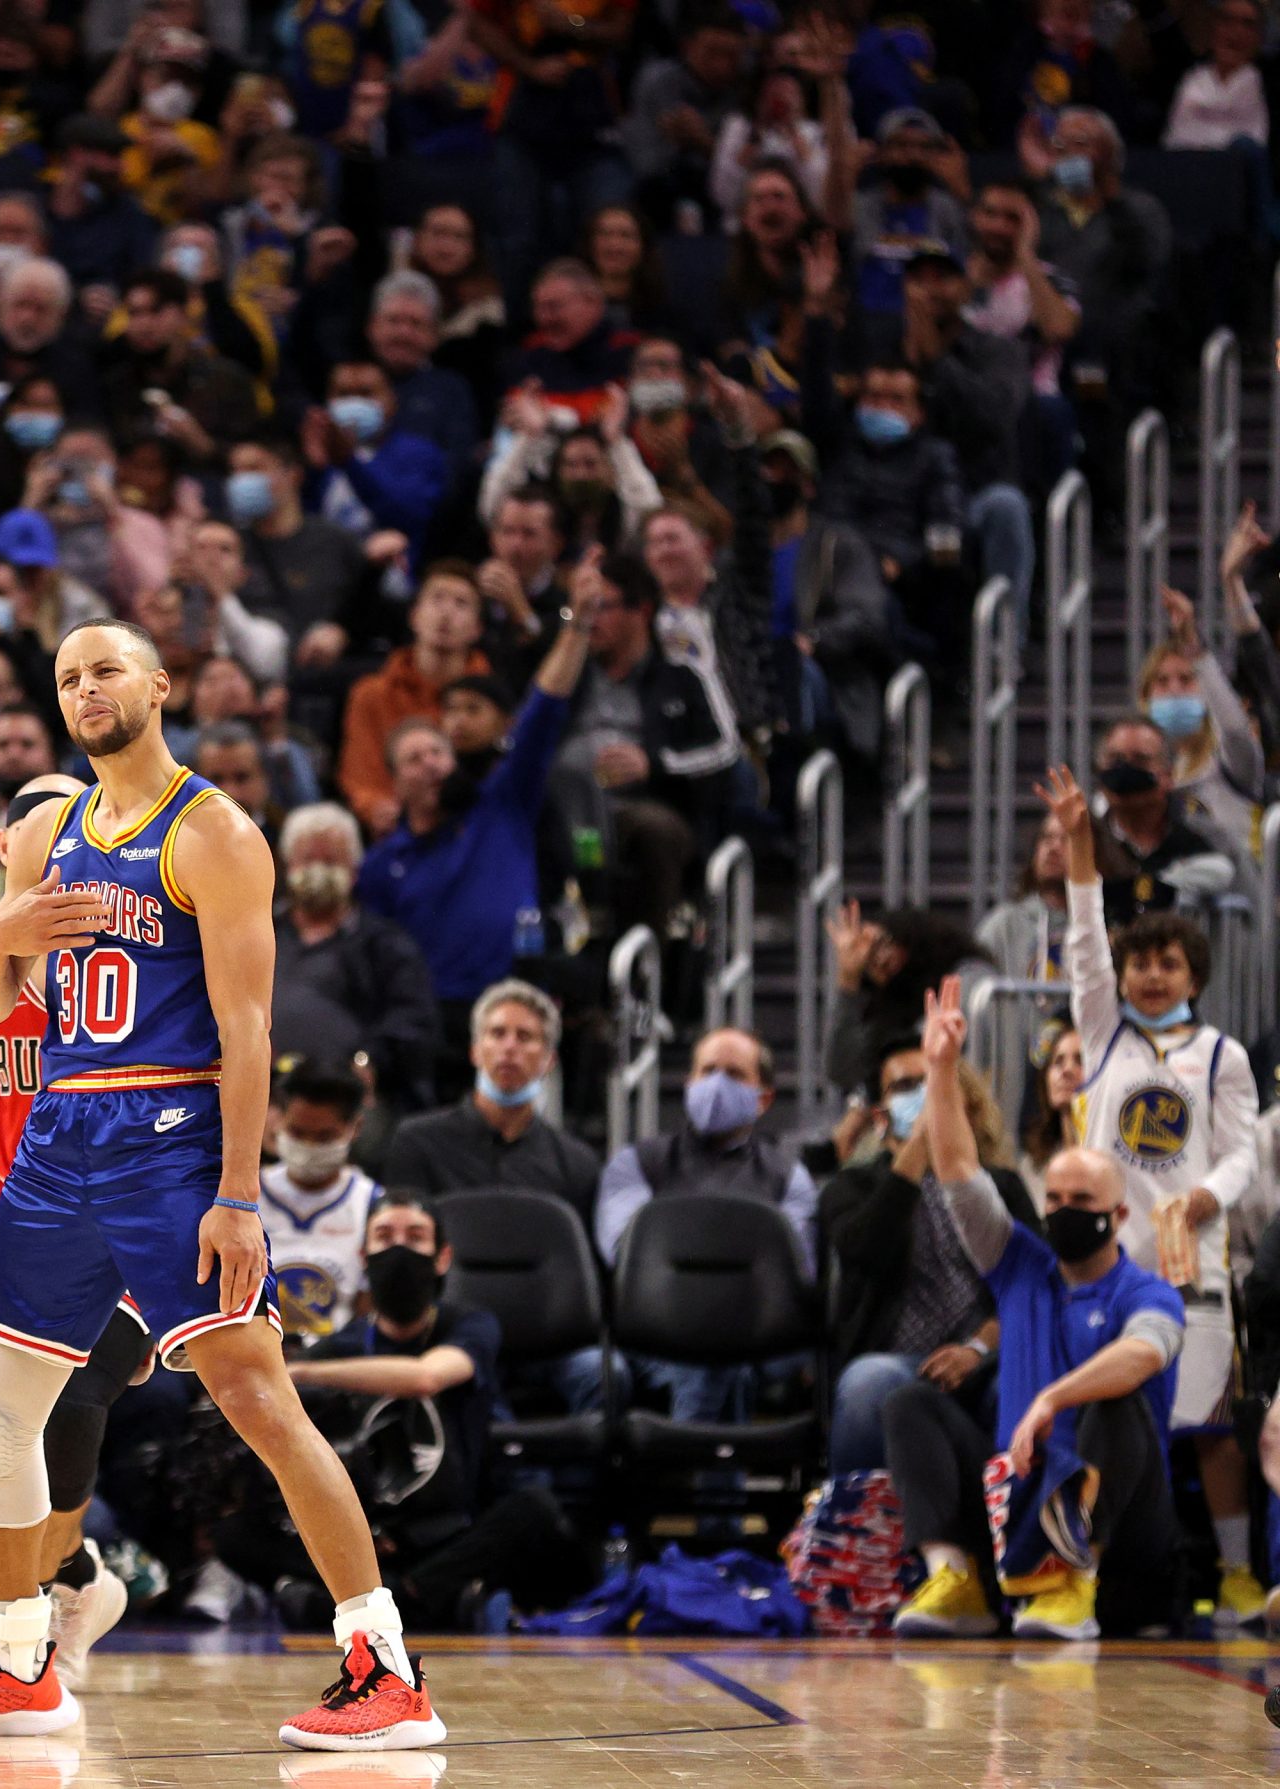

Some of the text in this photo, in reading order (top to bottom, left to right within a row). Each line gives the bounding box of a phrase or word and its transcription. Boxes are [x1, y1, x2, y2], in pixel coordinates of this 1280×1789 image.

[120, 848, 159, 860] Rakuten
[56, 948, 137, 1044] 30
[159, 1107, 186, 1123] NIKE
